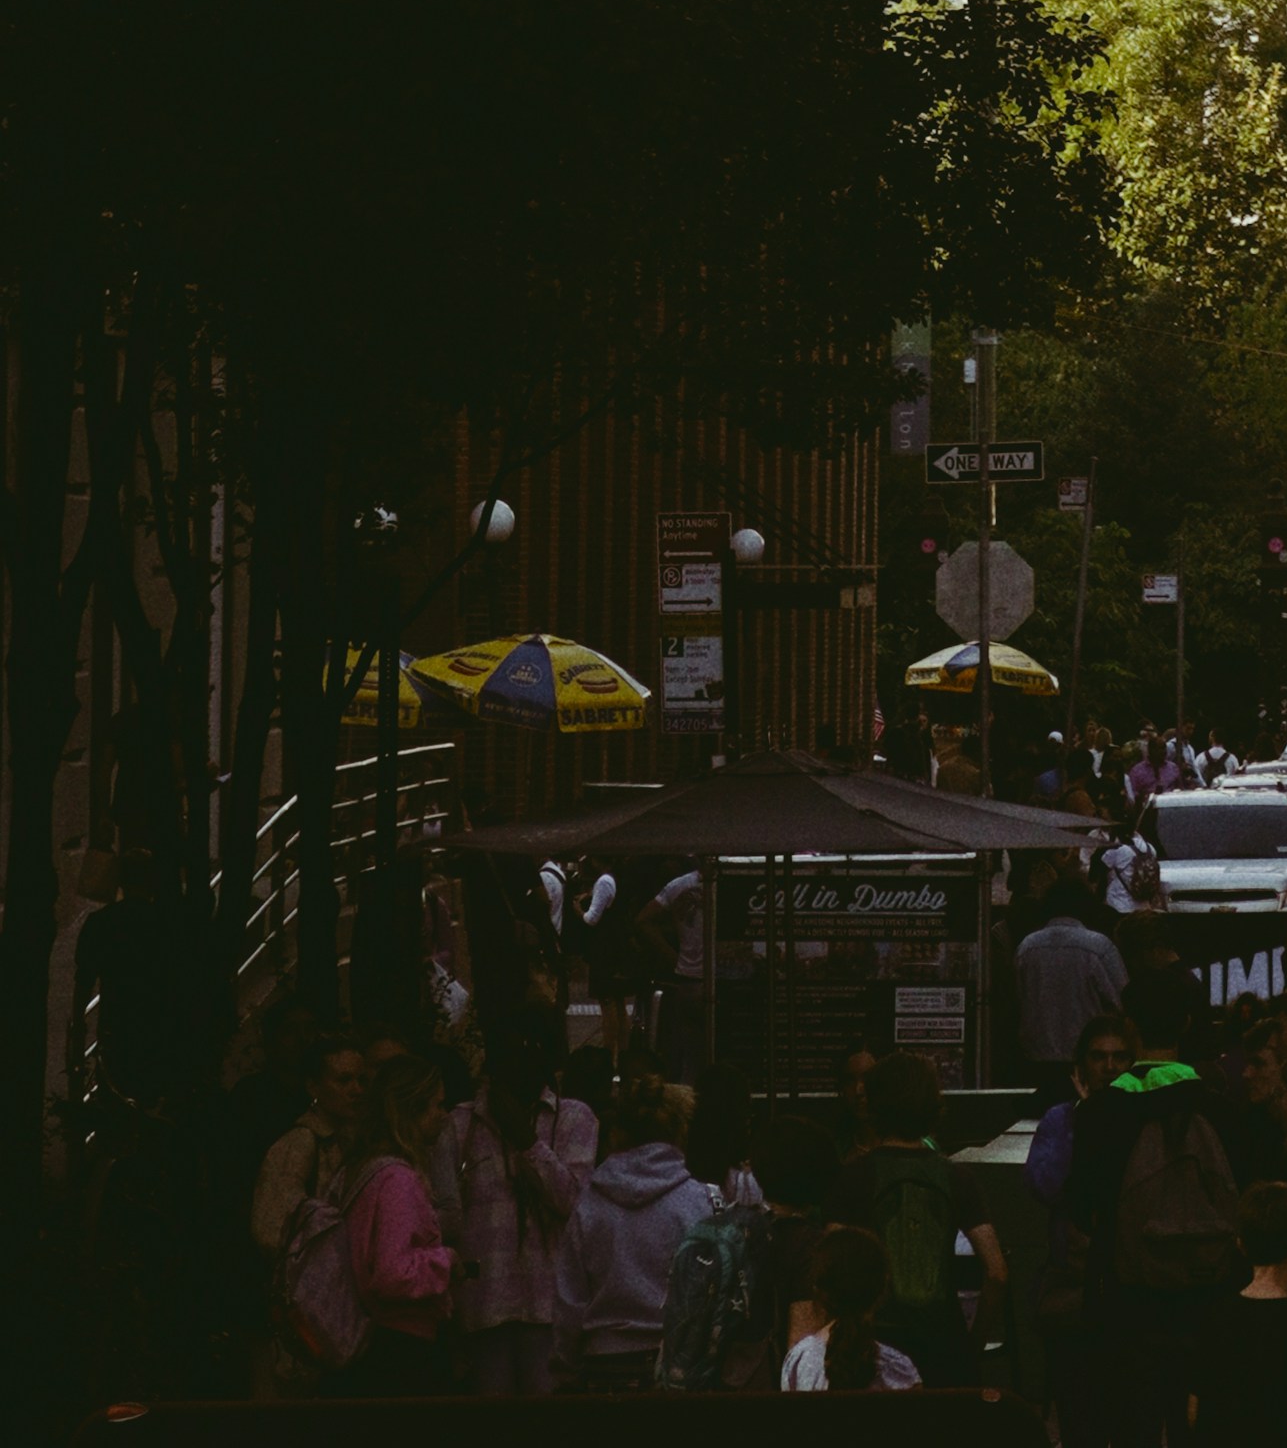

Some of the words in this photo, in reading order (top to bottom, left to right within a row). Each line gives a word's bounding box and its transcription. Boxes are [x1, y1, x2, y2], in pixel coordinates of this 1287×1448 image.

[945, 454, 978, 470] ONE
[993, 454, 1027, 469] WAY
[662, 518, 674, 528] NO
[675, 517, 719, 529] STANDING
[662, 530, 698, 542] Anytime
[667, 637, 678, 656] 2
[560, 706, 644, 727] SABRETT
[811, 885, 840, 909] in
[847, 883, 948, 913] Dumbo
